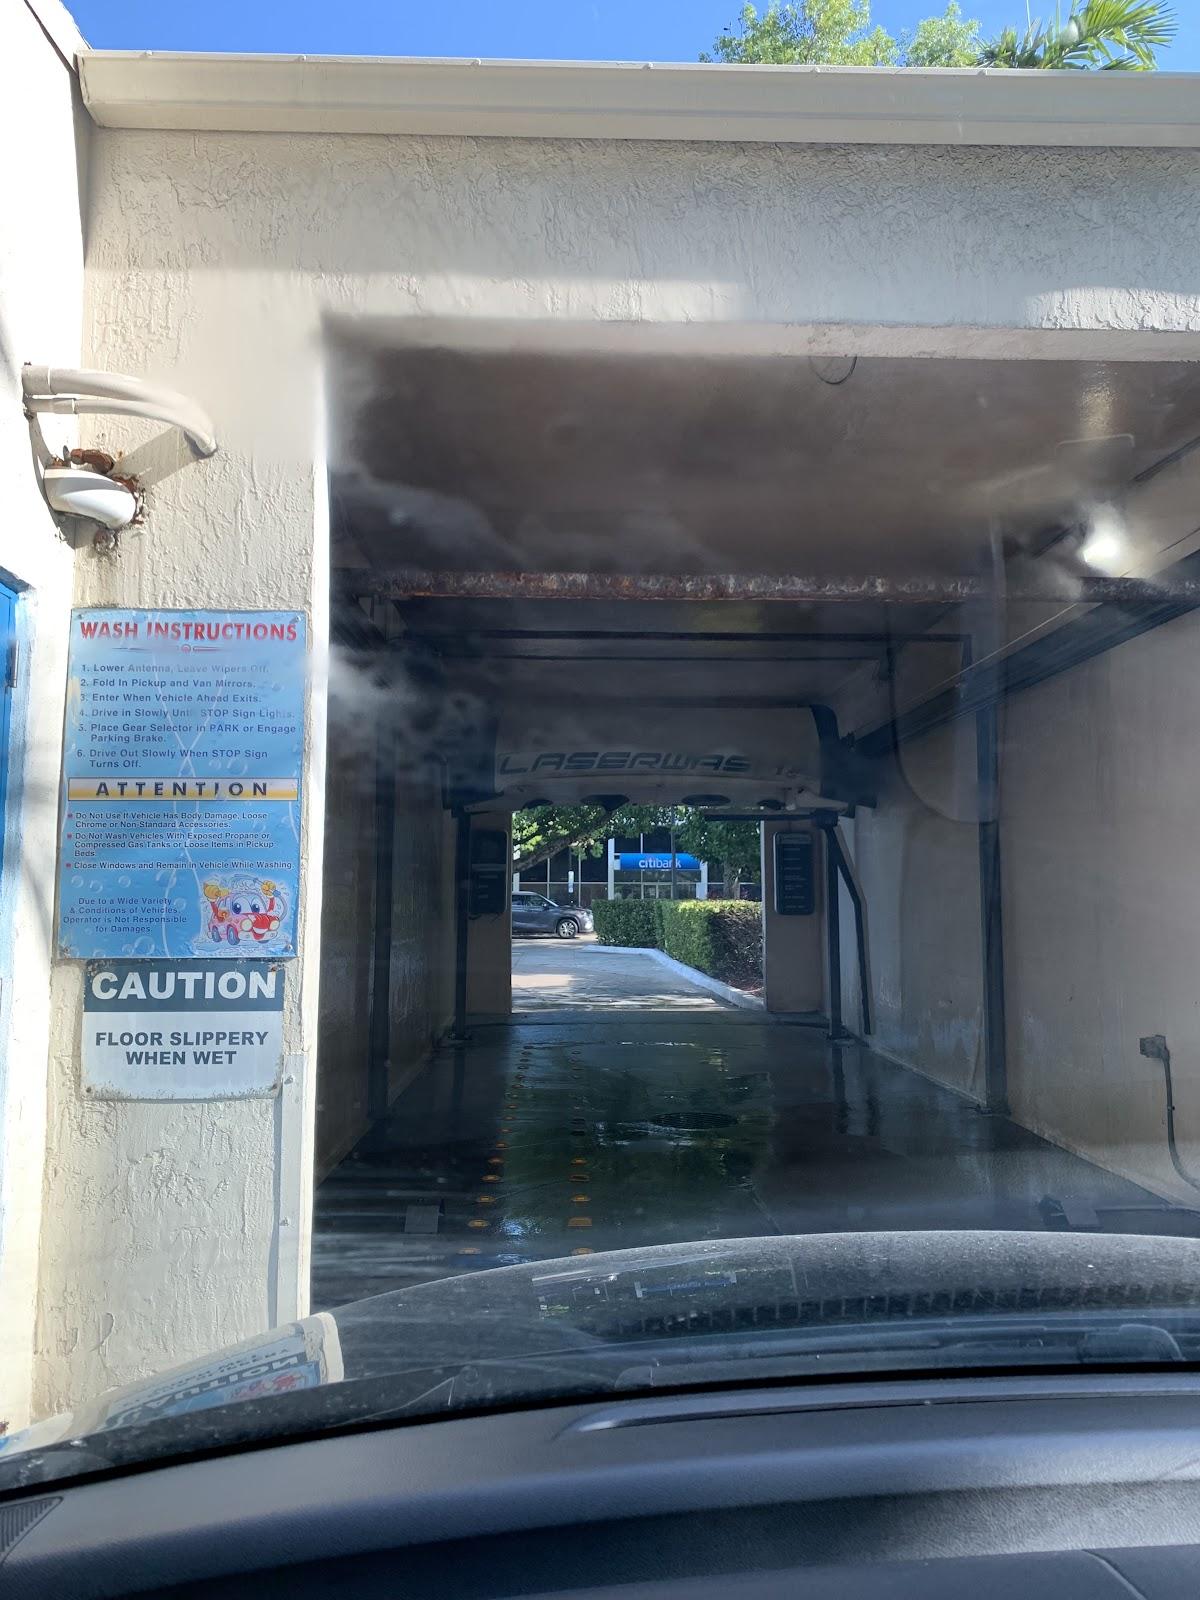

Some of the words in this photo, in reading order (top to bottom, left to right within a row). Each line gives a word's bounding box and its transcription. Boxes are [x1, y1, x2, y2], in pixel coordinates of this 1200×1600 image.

[80, 621, 138, 640] WASH
[147, 621, 297, 641] INSTRUCTIONS
[93, 664, 125, 672] Lower
[127, 664, 174, 675] Antenna,
[178, 664, 207, 673] Leave
[93, 679, 115, 687] Fold
[131, 679, 167, 689] Pickup
[169, 679, 189, 687] and
[215, 680, 256, 688] Mirrors.
[92, 694, 119, 702] Enter
[123, 694, 151, 702] When
[155, 694, 193, 702] Vehicle
[196, 694, 229, 702] Ahead
[91, 709, 118, 717] Drive
[134, 709, 169, 718] Slowly
[172, 709, 193, 717] Unt
[200, 709, 229, 717] STOP
[232, 709, 256, 719] Sign
[90, 724, 119, 732] Place
[122, 724, 146, 732] Gear
[150, 724, 192, 732] Selector
[209, 724, 239, 732] PARK
[257, 724, 296, 734] Engage
[90, 734, 130, 743] Parking
[134, 734, 166, 742] Brake.
[89, 750, 117, 758] Drive
[142, 750, 176, 759] Slowly
[180, 750, 208, 758] When
[244, 750, 268, 759] Sign
[89, 760, 119, 768] Turns
[123, 760, 141, 768] Off.
[95, 782, 268, 796] ATTENTION
[181, 812, 202, 820] Body
[187, 832, 223, 841] Exposed
[225, 832, 258, 841] Propane
[75, 841, 126, 849] Compressed
[246, 841, 274, 849] Pickup
[142, 898, 172, 906] Variety
[63, 916, 102, 925] Operator
[104, 916, 112, 924] is
[114, 916, 130, 924] Not
[132, 916, 187, 925] Responsible
[111, 926, 153, 934] Damages.
[91, 971, 276, 1000] CAUTION
[95, 1031, 163, 1046] FLOOR
[169, 1031, 269, 1046] SLIPPERY
[125, 1051, 186, 1065] WHEN
[193, 1051, 237, 1065] WET
